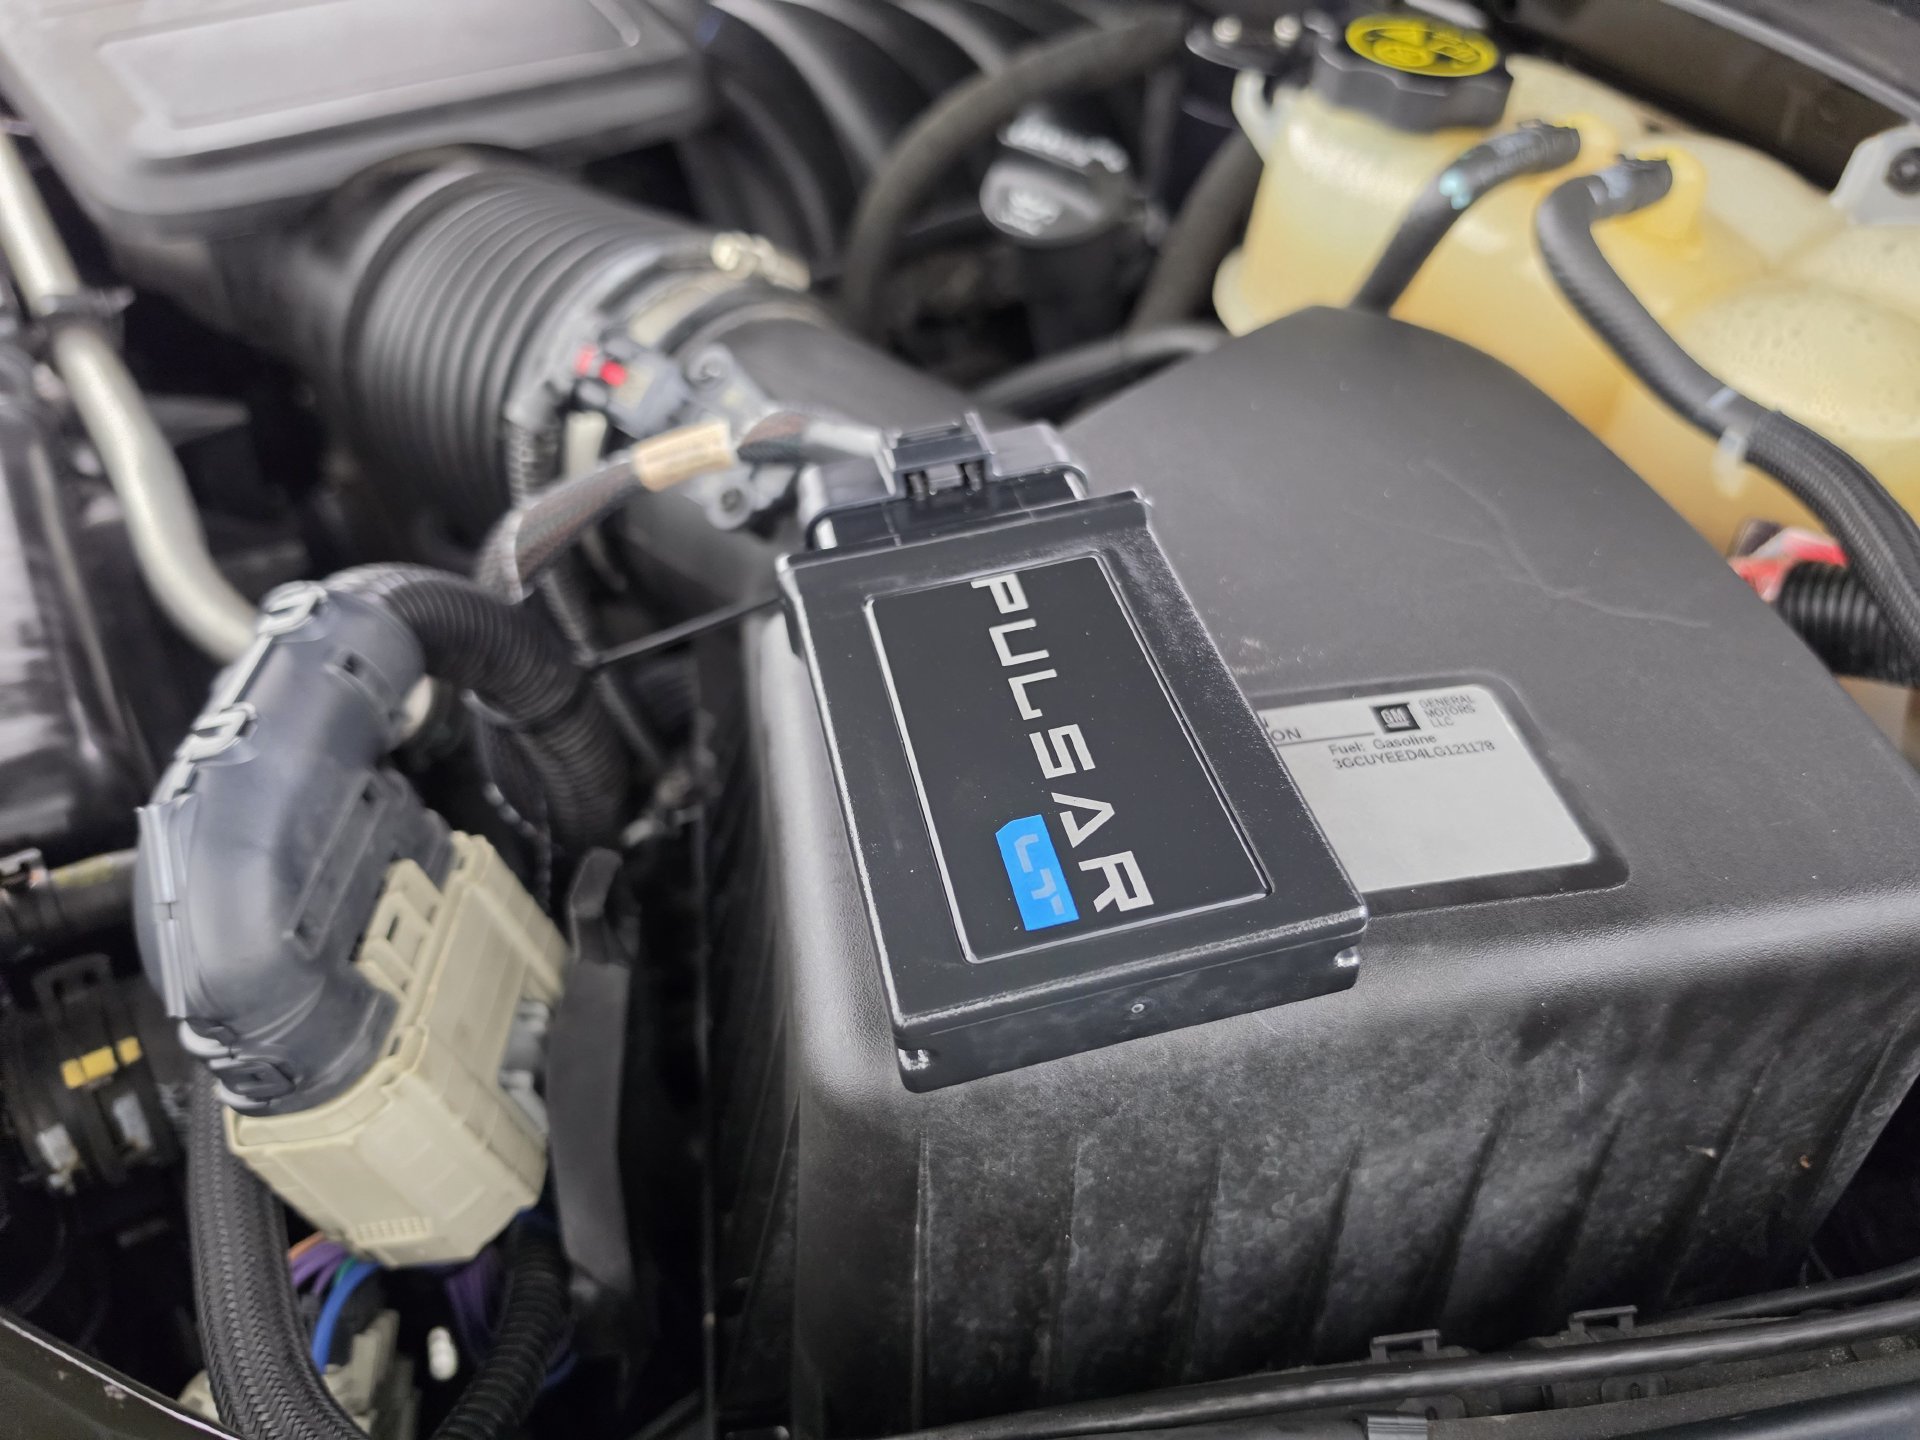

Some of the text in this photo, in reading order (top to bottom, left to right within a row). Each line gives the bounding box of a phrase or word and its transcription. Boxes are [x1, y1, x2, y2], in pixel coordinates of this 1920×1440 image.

[1419, 695, 1474, 709] GENERAL
[1424, 704, 1476, 718] MOTORS
[1430, 716, 1455, 729] LLC
[971, 573, 1154, 912] PULSAR
[1328, 734, 1437, 756] Fuel: Gasoline
[1332, 740, 1496, 770] 3GCUYEED4LG121178
